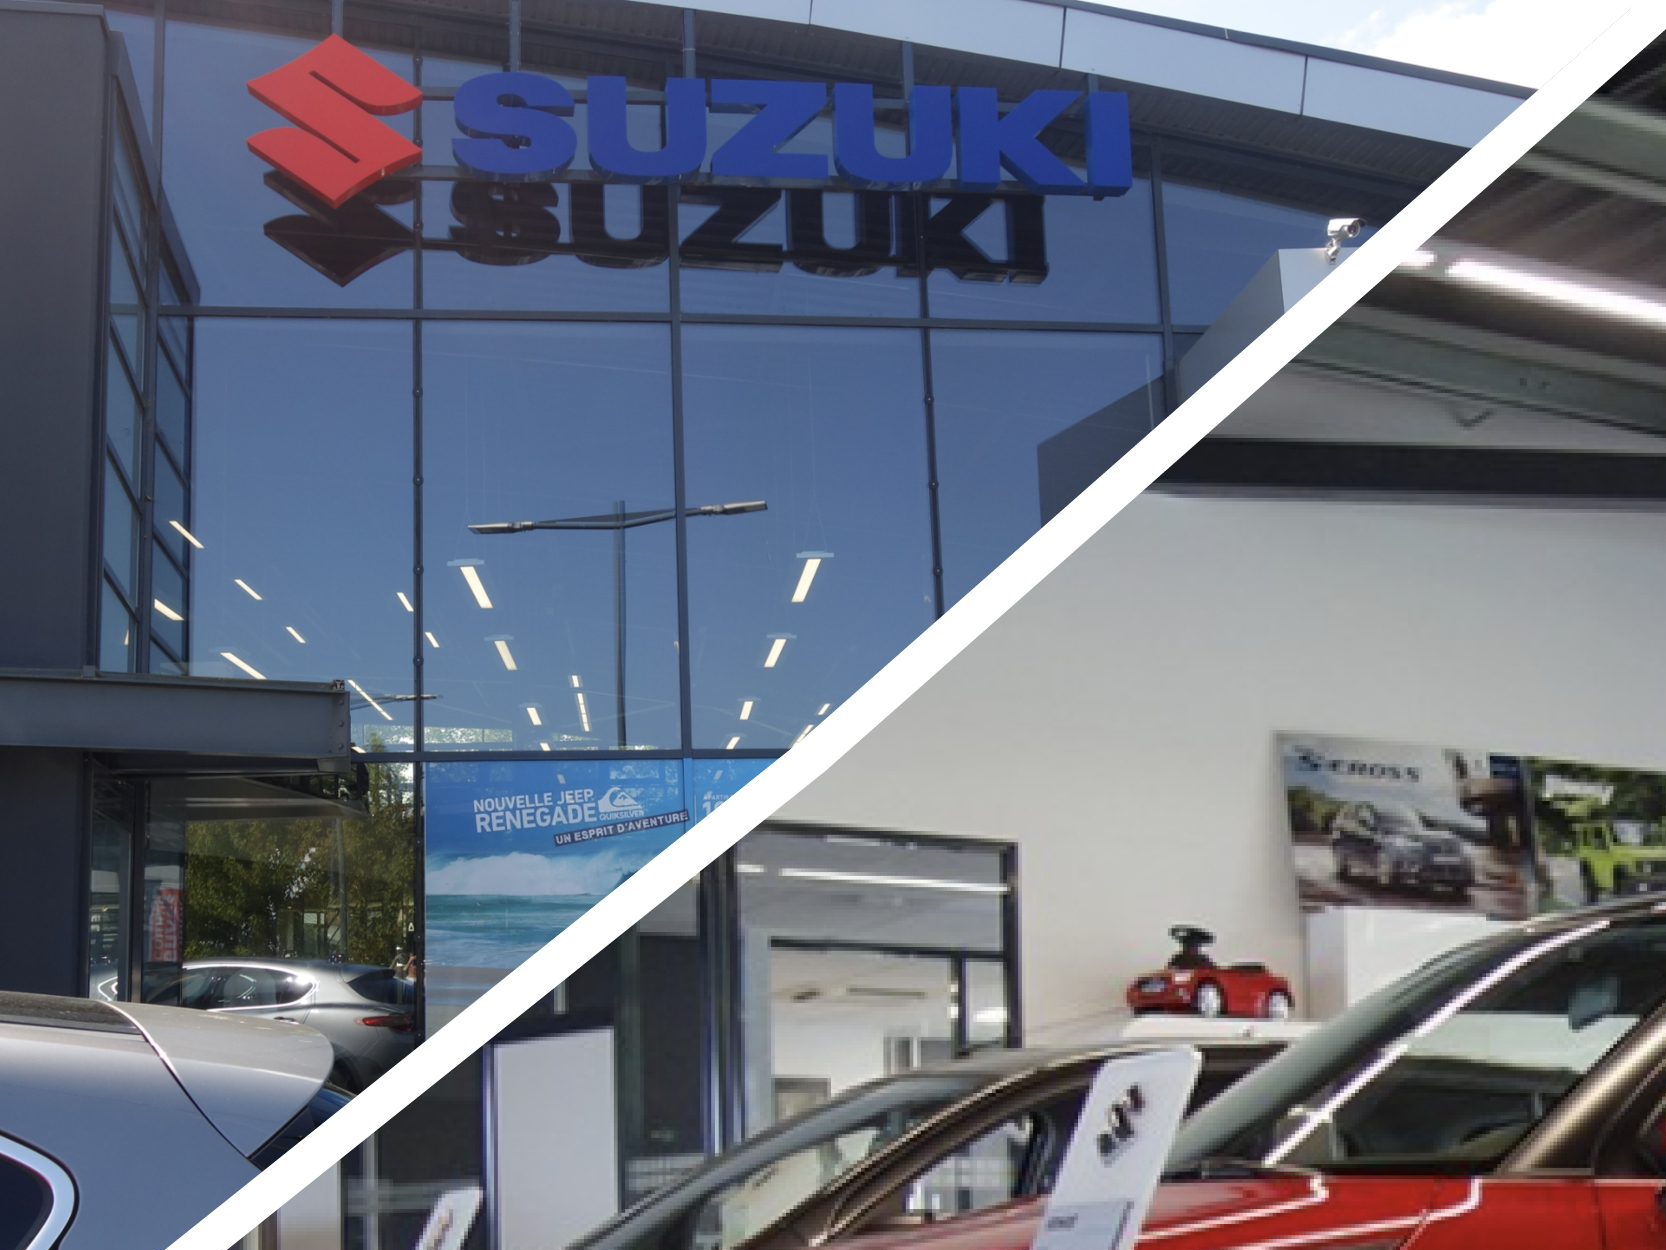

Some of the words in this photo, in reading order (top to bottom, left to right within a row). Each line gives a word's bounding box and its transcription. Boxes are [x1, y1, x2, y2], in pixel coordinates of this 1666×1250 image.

[451, 72, 1132, 197] SUZUKI
[449, 180, 1050, 284] SUZUKI
[473, 792, 553, 813] NOUVELLE
[475, 803, 597, 833] RENEGADE
[599, 810, 645, 821] QUIKSILVER
[555, 834, 572, 845] UN
[574, 826, 614, 841] ESPRIT
[617, 812, 689, 834] D'AVENTURE
